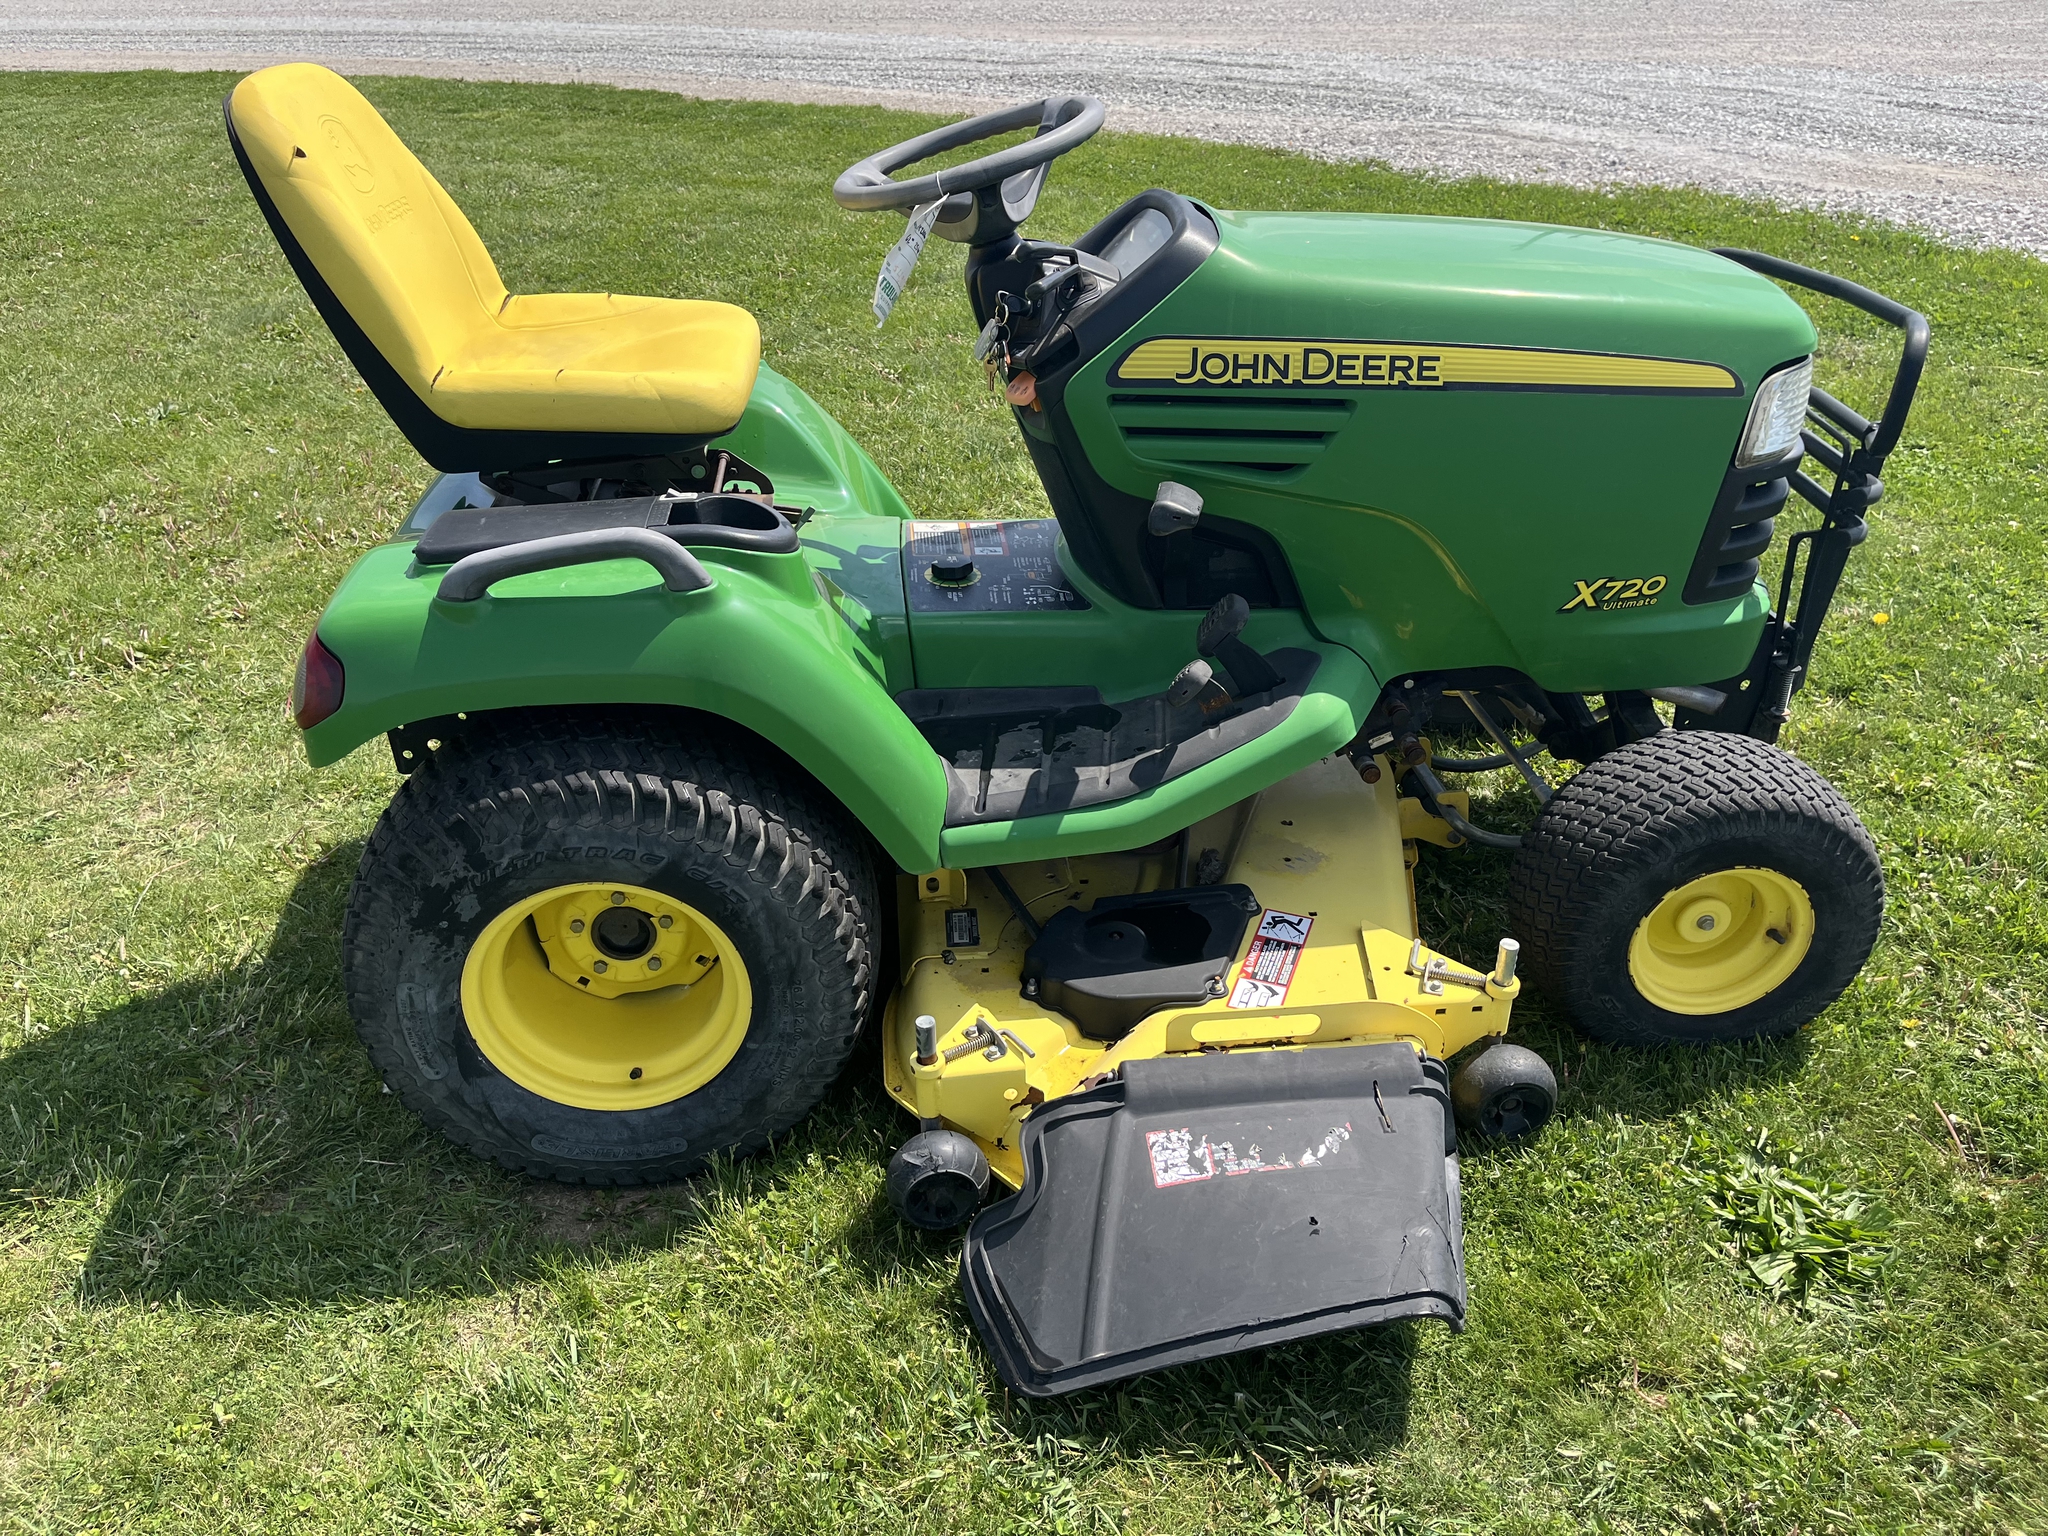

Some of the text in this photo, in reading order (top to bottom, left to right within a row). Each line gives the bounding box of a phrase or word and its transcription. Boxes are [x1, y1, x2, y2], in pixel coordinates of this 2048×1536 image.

[1174, 346, 1442, 383] JOHN DEERE
[1559, 574, 1668, 611] X720
[1602, 597, 1658, 611] Ultimate
[1246, 941, 1262, 965] DANGER
